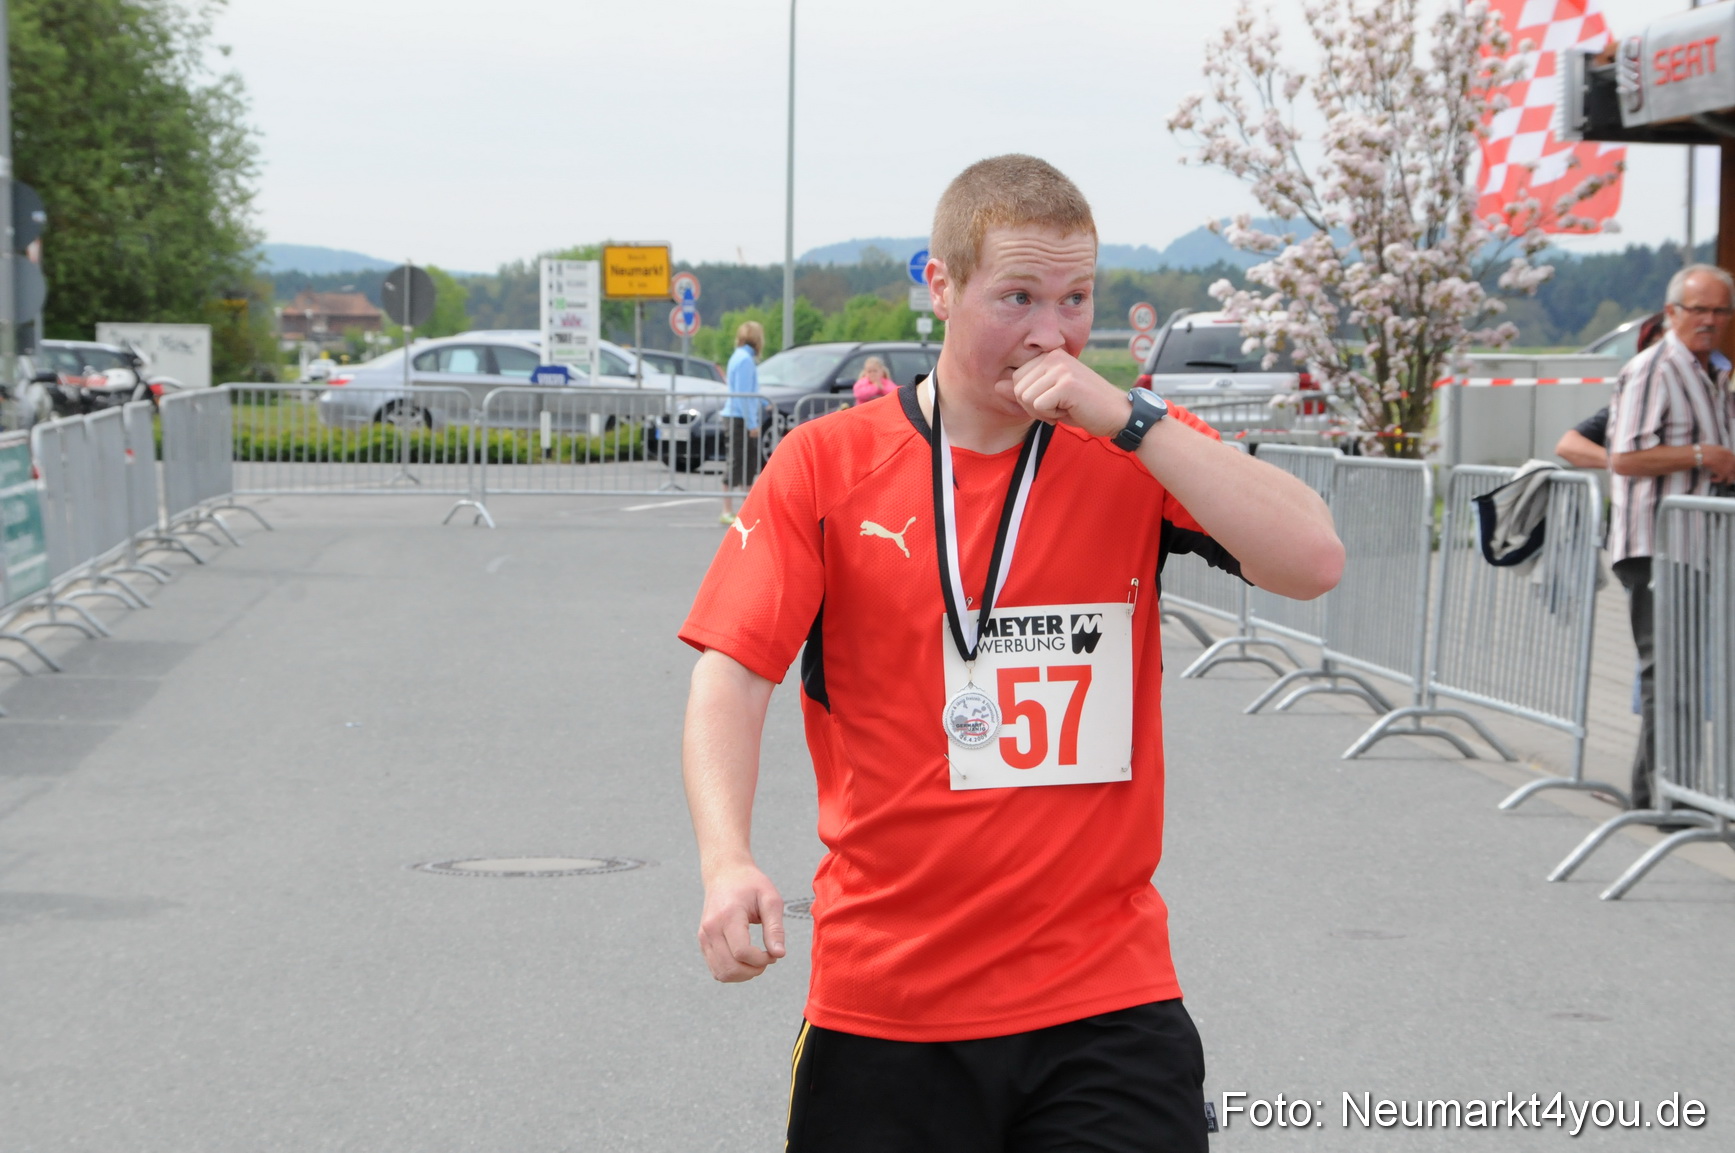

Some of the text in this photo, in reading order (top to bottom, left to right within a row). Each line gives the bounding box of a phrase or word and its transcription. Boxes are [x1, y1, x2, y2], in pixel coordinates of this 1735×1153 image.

[1653, 35, 1720, 86] SEAT
[611, 264, 664, 277] Neumarkt
[977, 615, 1064, 637] MEYER
[977, 637, 1066, 654] WERBUNG
[996, 664, 1093, 770] 57
